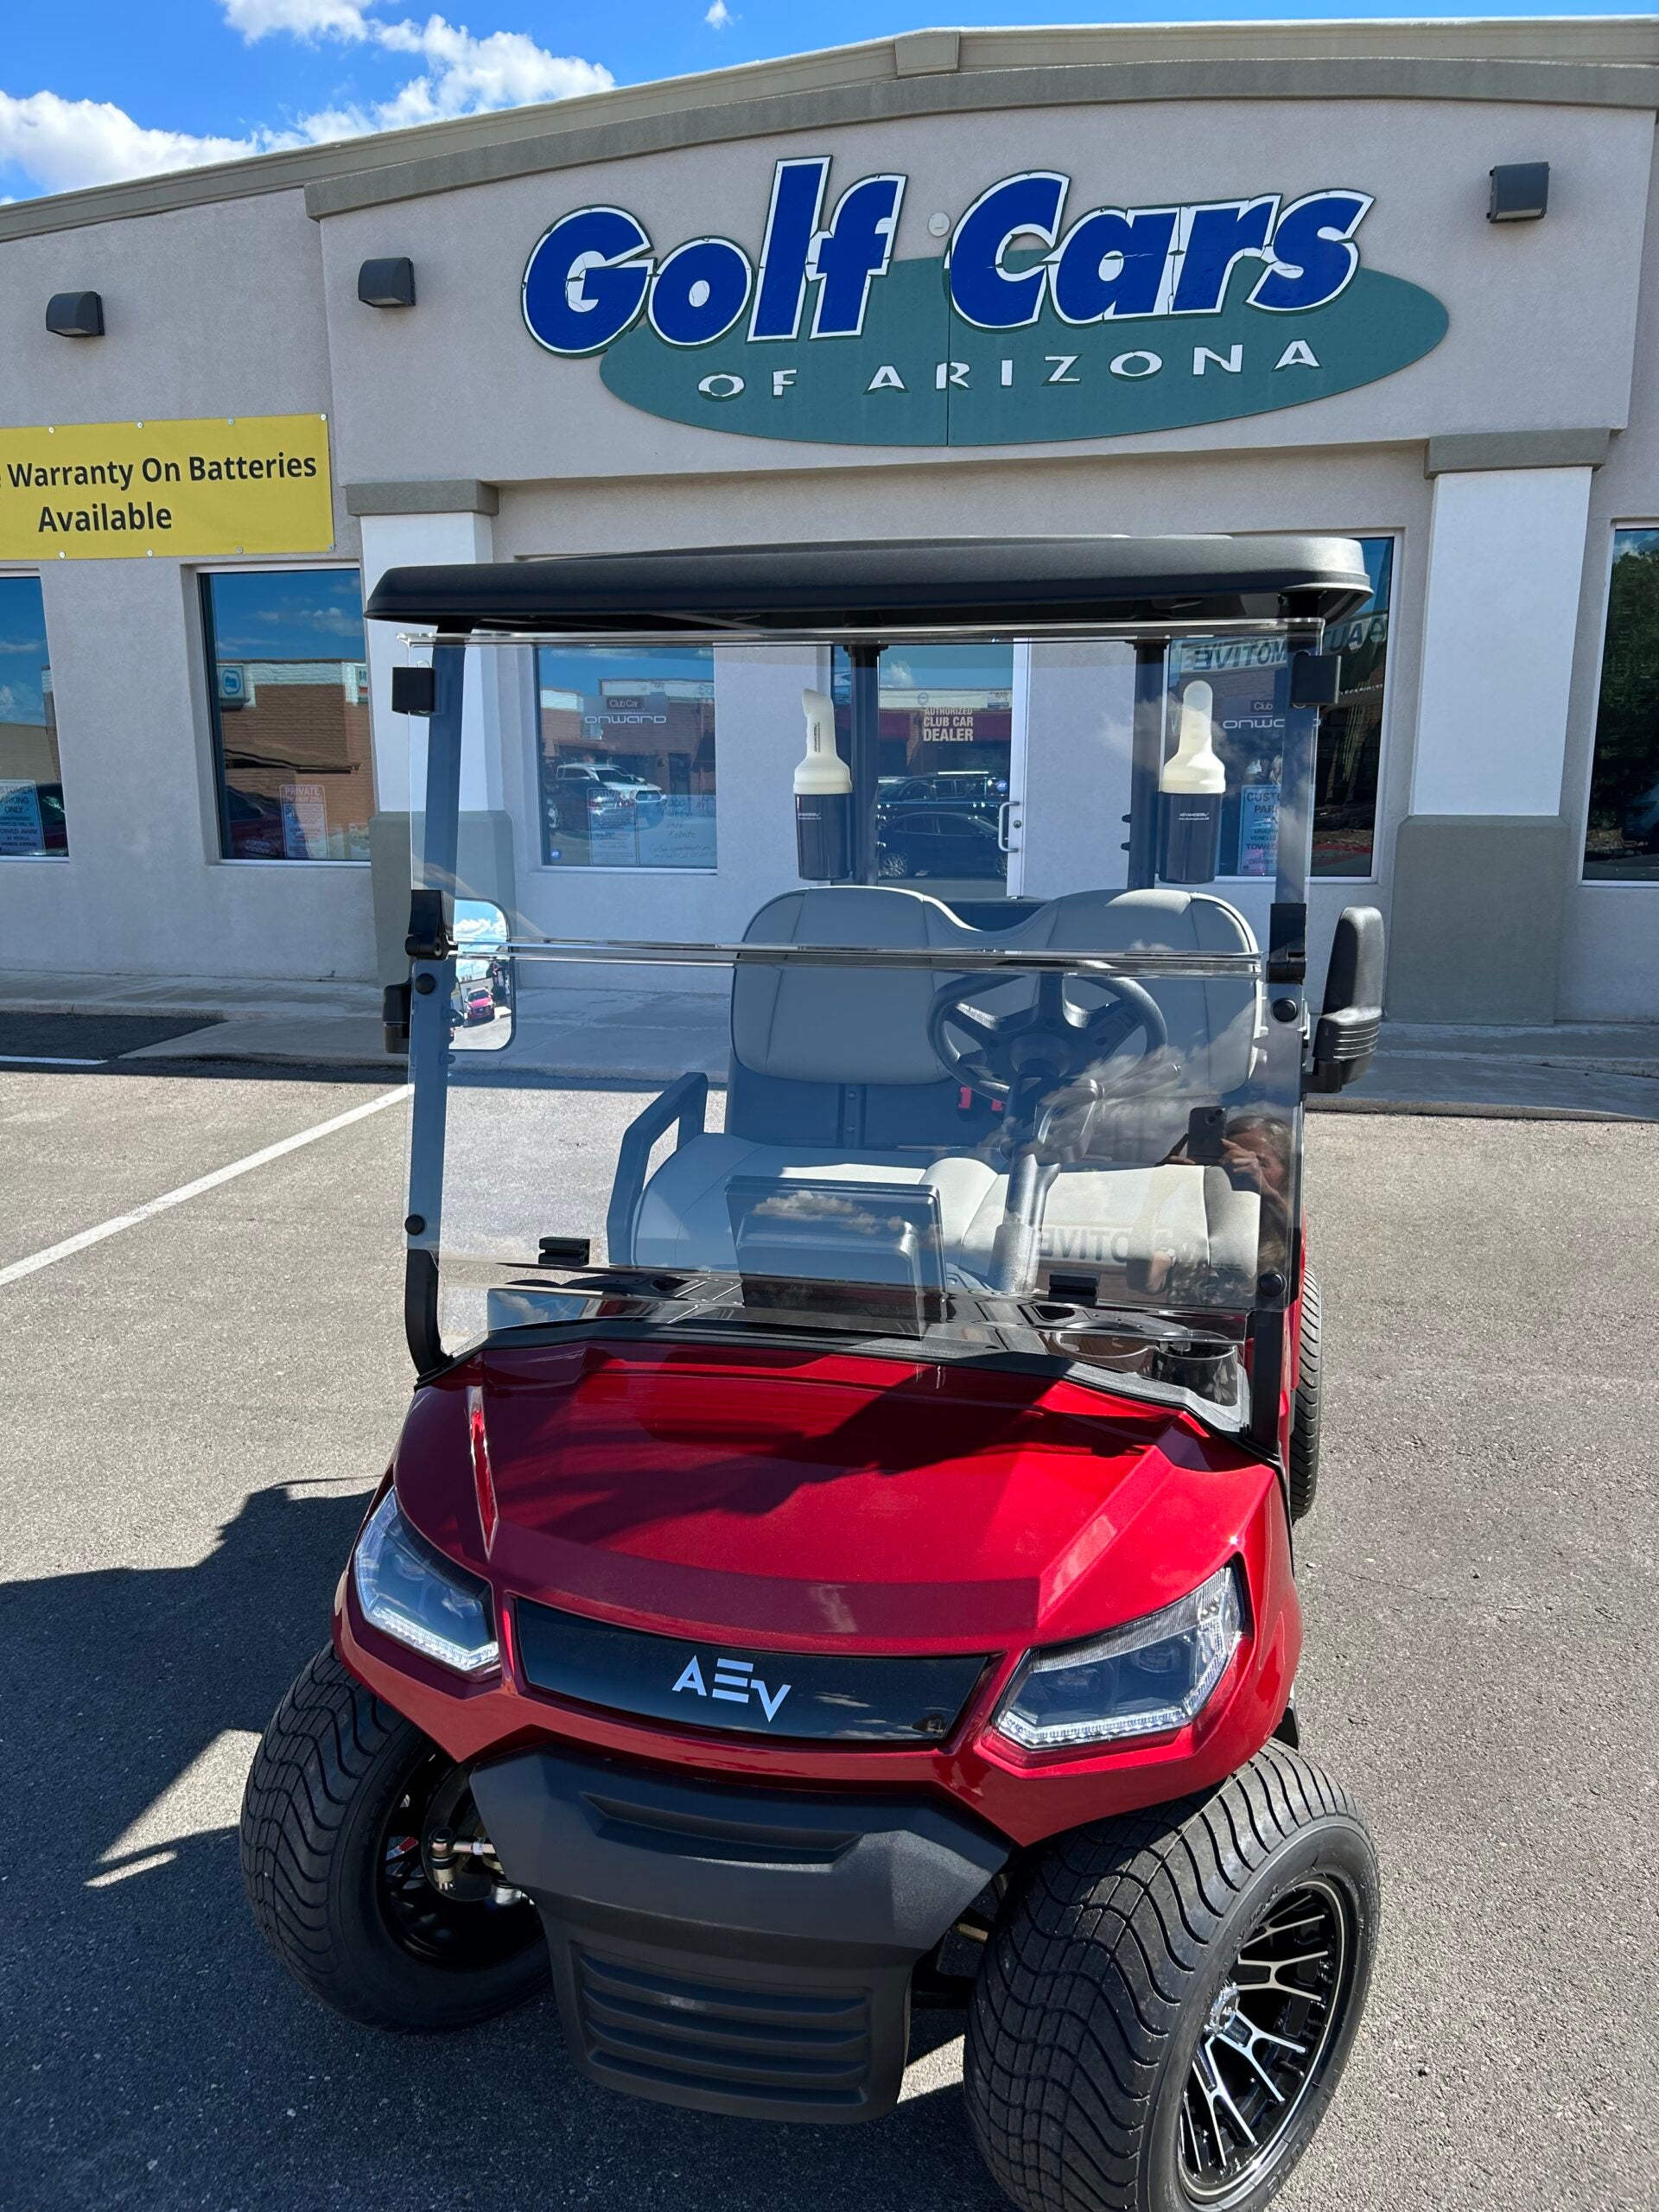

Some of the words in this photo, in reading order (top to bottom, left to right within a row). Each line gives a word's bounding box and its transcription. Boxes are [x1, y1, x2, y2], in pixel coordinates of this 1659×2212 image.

[522, 156, 908, 357] Golf
[947, 170, 1374, 333] Cars
[698, 369, 798, 400] OF
[864, 340, 1322, 394] ARIZONA
[7, 461, 133, 492] Warranty
[142, 458, 180, 482] On
[188, 452, 317, 481] Batteries
[38, 501, 173, 532] Available
[610, 699, 626, 708] Club
[626, 699, 639, 708] Car
[1254, 702, 1273, 711] Club
[925, 707, 973, 715] AUTHORIZED
[923, 716, 950, 727] CLUB
[952, 716, 974, 727] CAR
[923, 728, 974, 741] DEALER
[284, 786, 320, 796] PRIVATE
[671, 1655, 791, 1723] AEV
